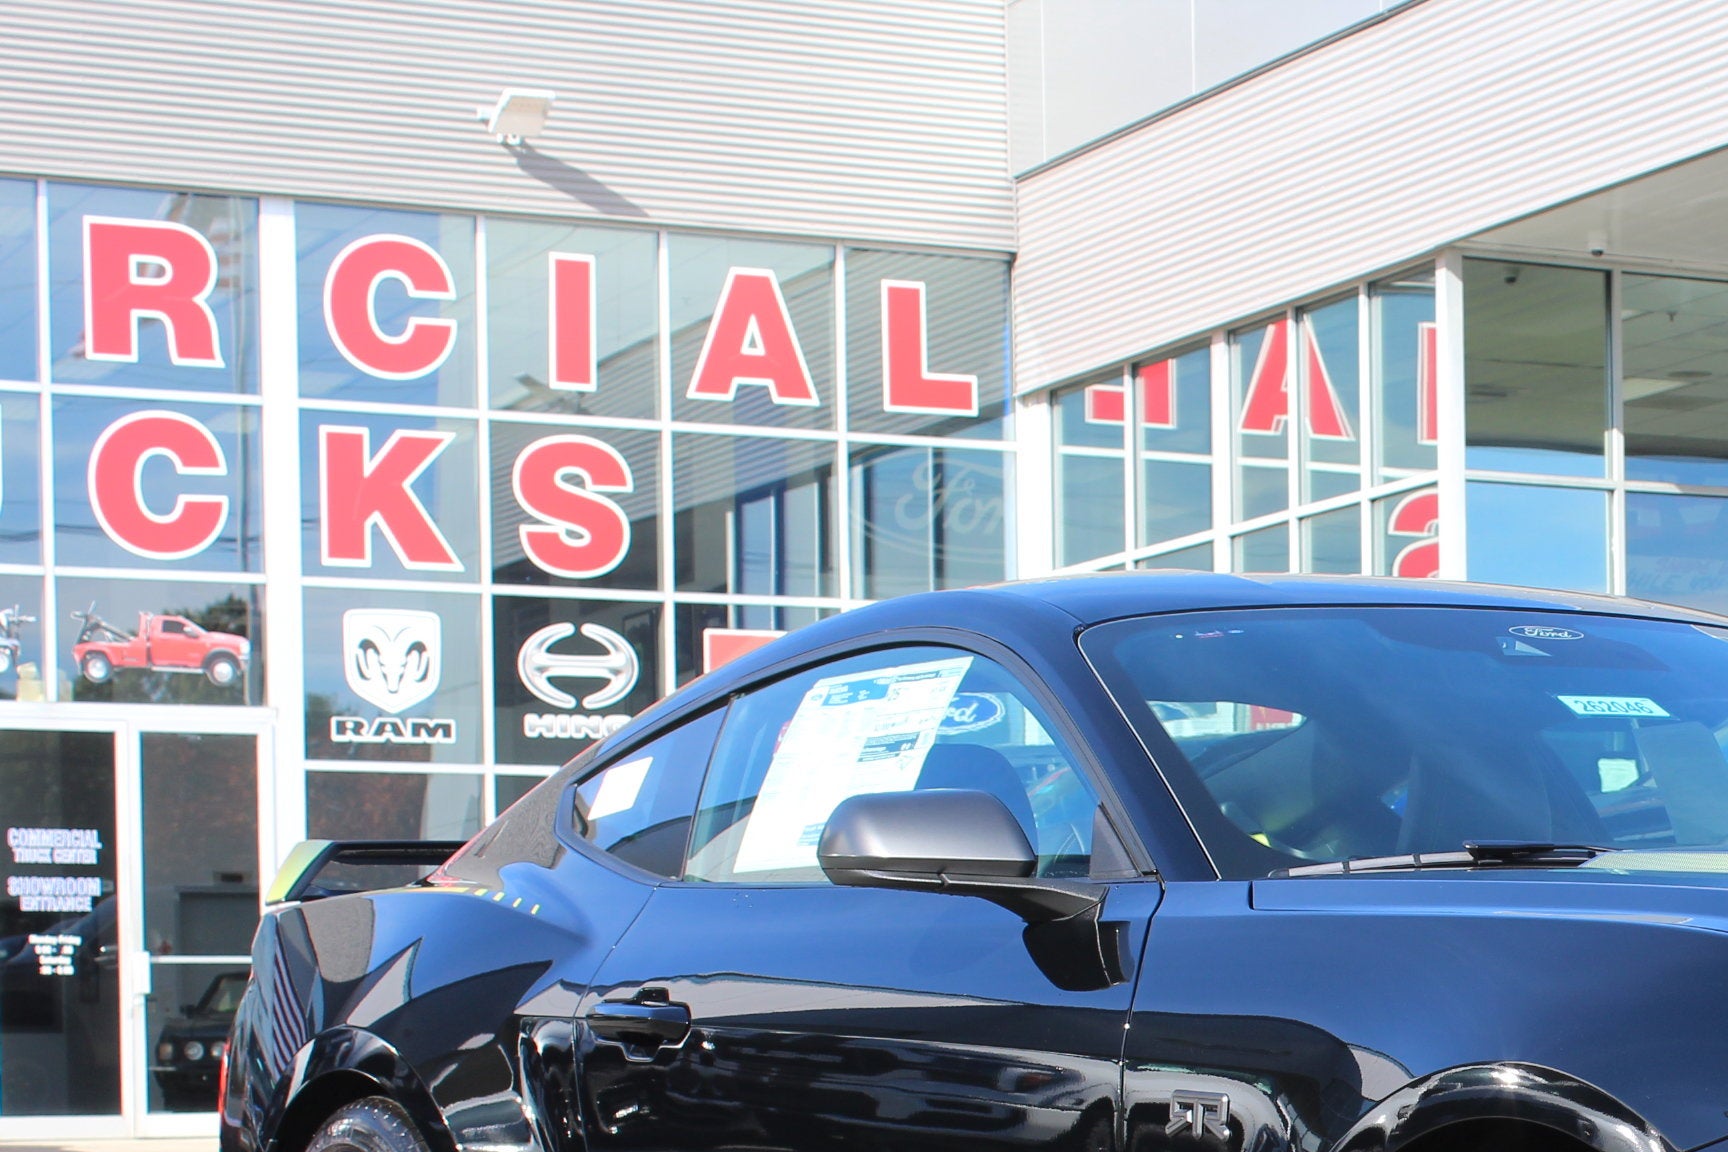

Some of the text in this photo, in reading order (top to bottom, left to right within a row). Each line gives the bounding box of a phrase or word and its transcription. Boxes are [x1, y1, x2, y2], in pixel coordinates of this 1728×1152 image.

[1524, 626, 1572, 638] Ford
[1574, 699, 1651, 714] 262046
[330, 715, 457, 743] RAM
[7, 827, 103, 849] COMMERCIAL
[7, 876, 102, 897] SHOWROOM
[20, 896, 93, 912] ENTRANCE
